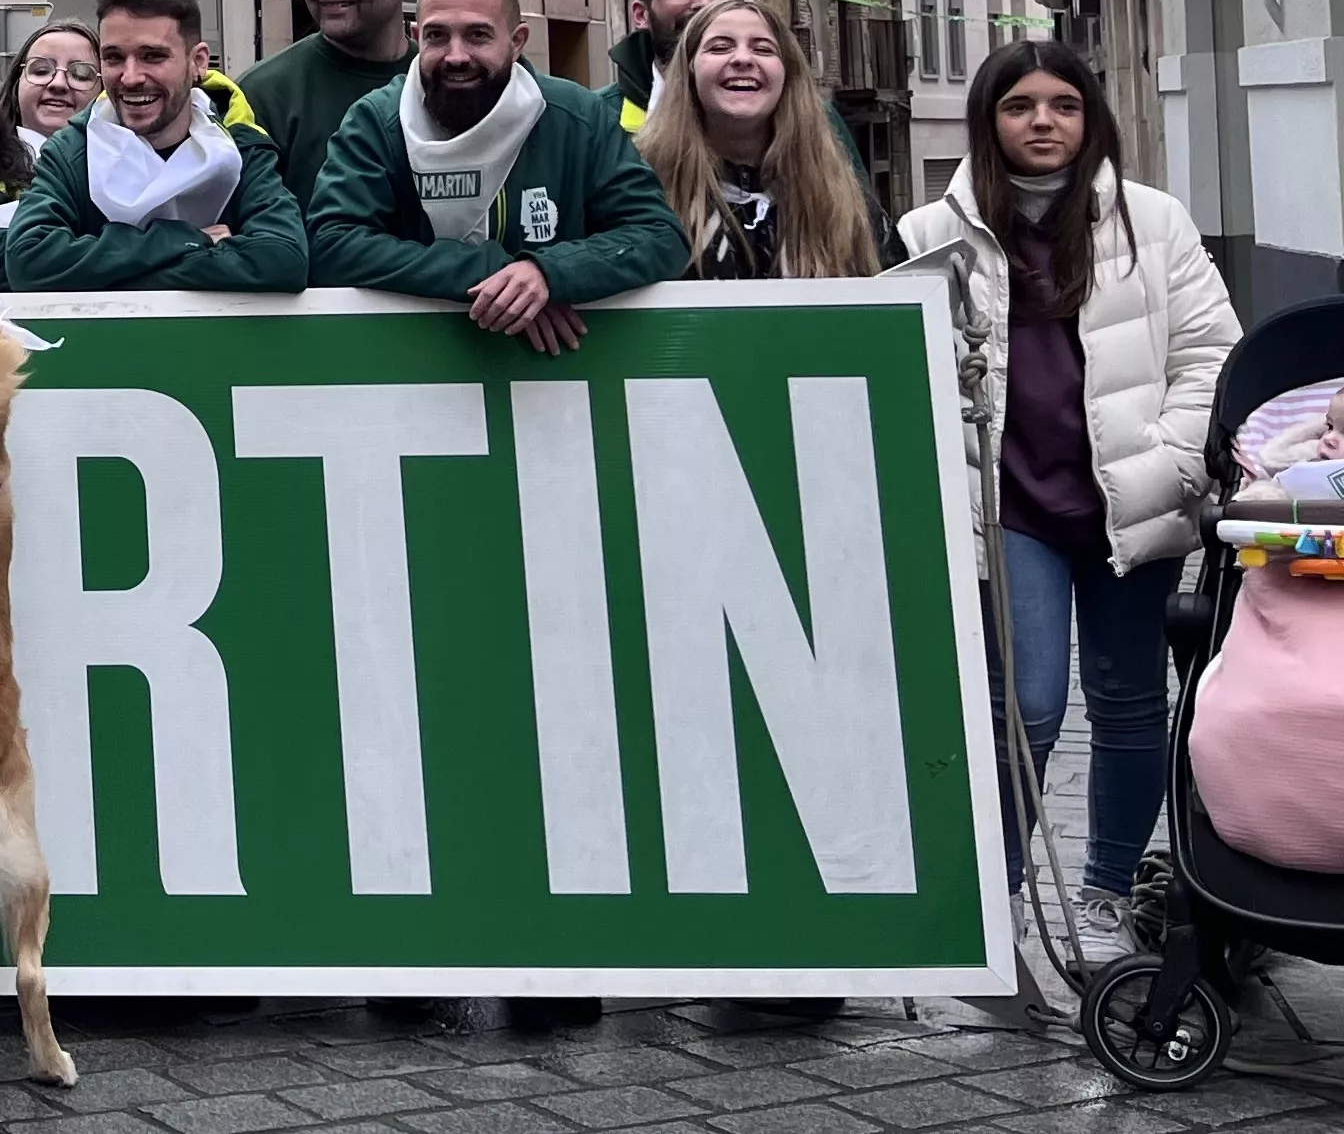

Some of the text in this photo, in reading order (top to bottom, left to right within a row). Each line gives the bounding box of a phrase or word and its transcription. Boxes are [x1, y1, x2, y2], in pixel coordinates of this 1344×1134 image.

[422, 173, 477, 198] MARTIN
[528, 200, 549, 214] SAN
[531, 212, 549, 224] MAR
[532, 223, 551, 240] TIN
